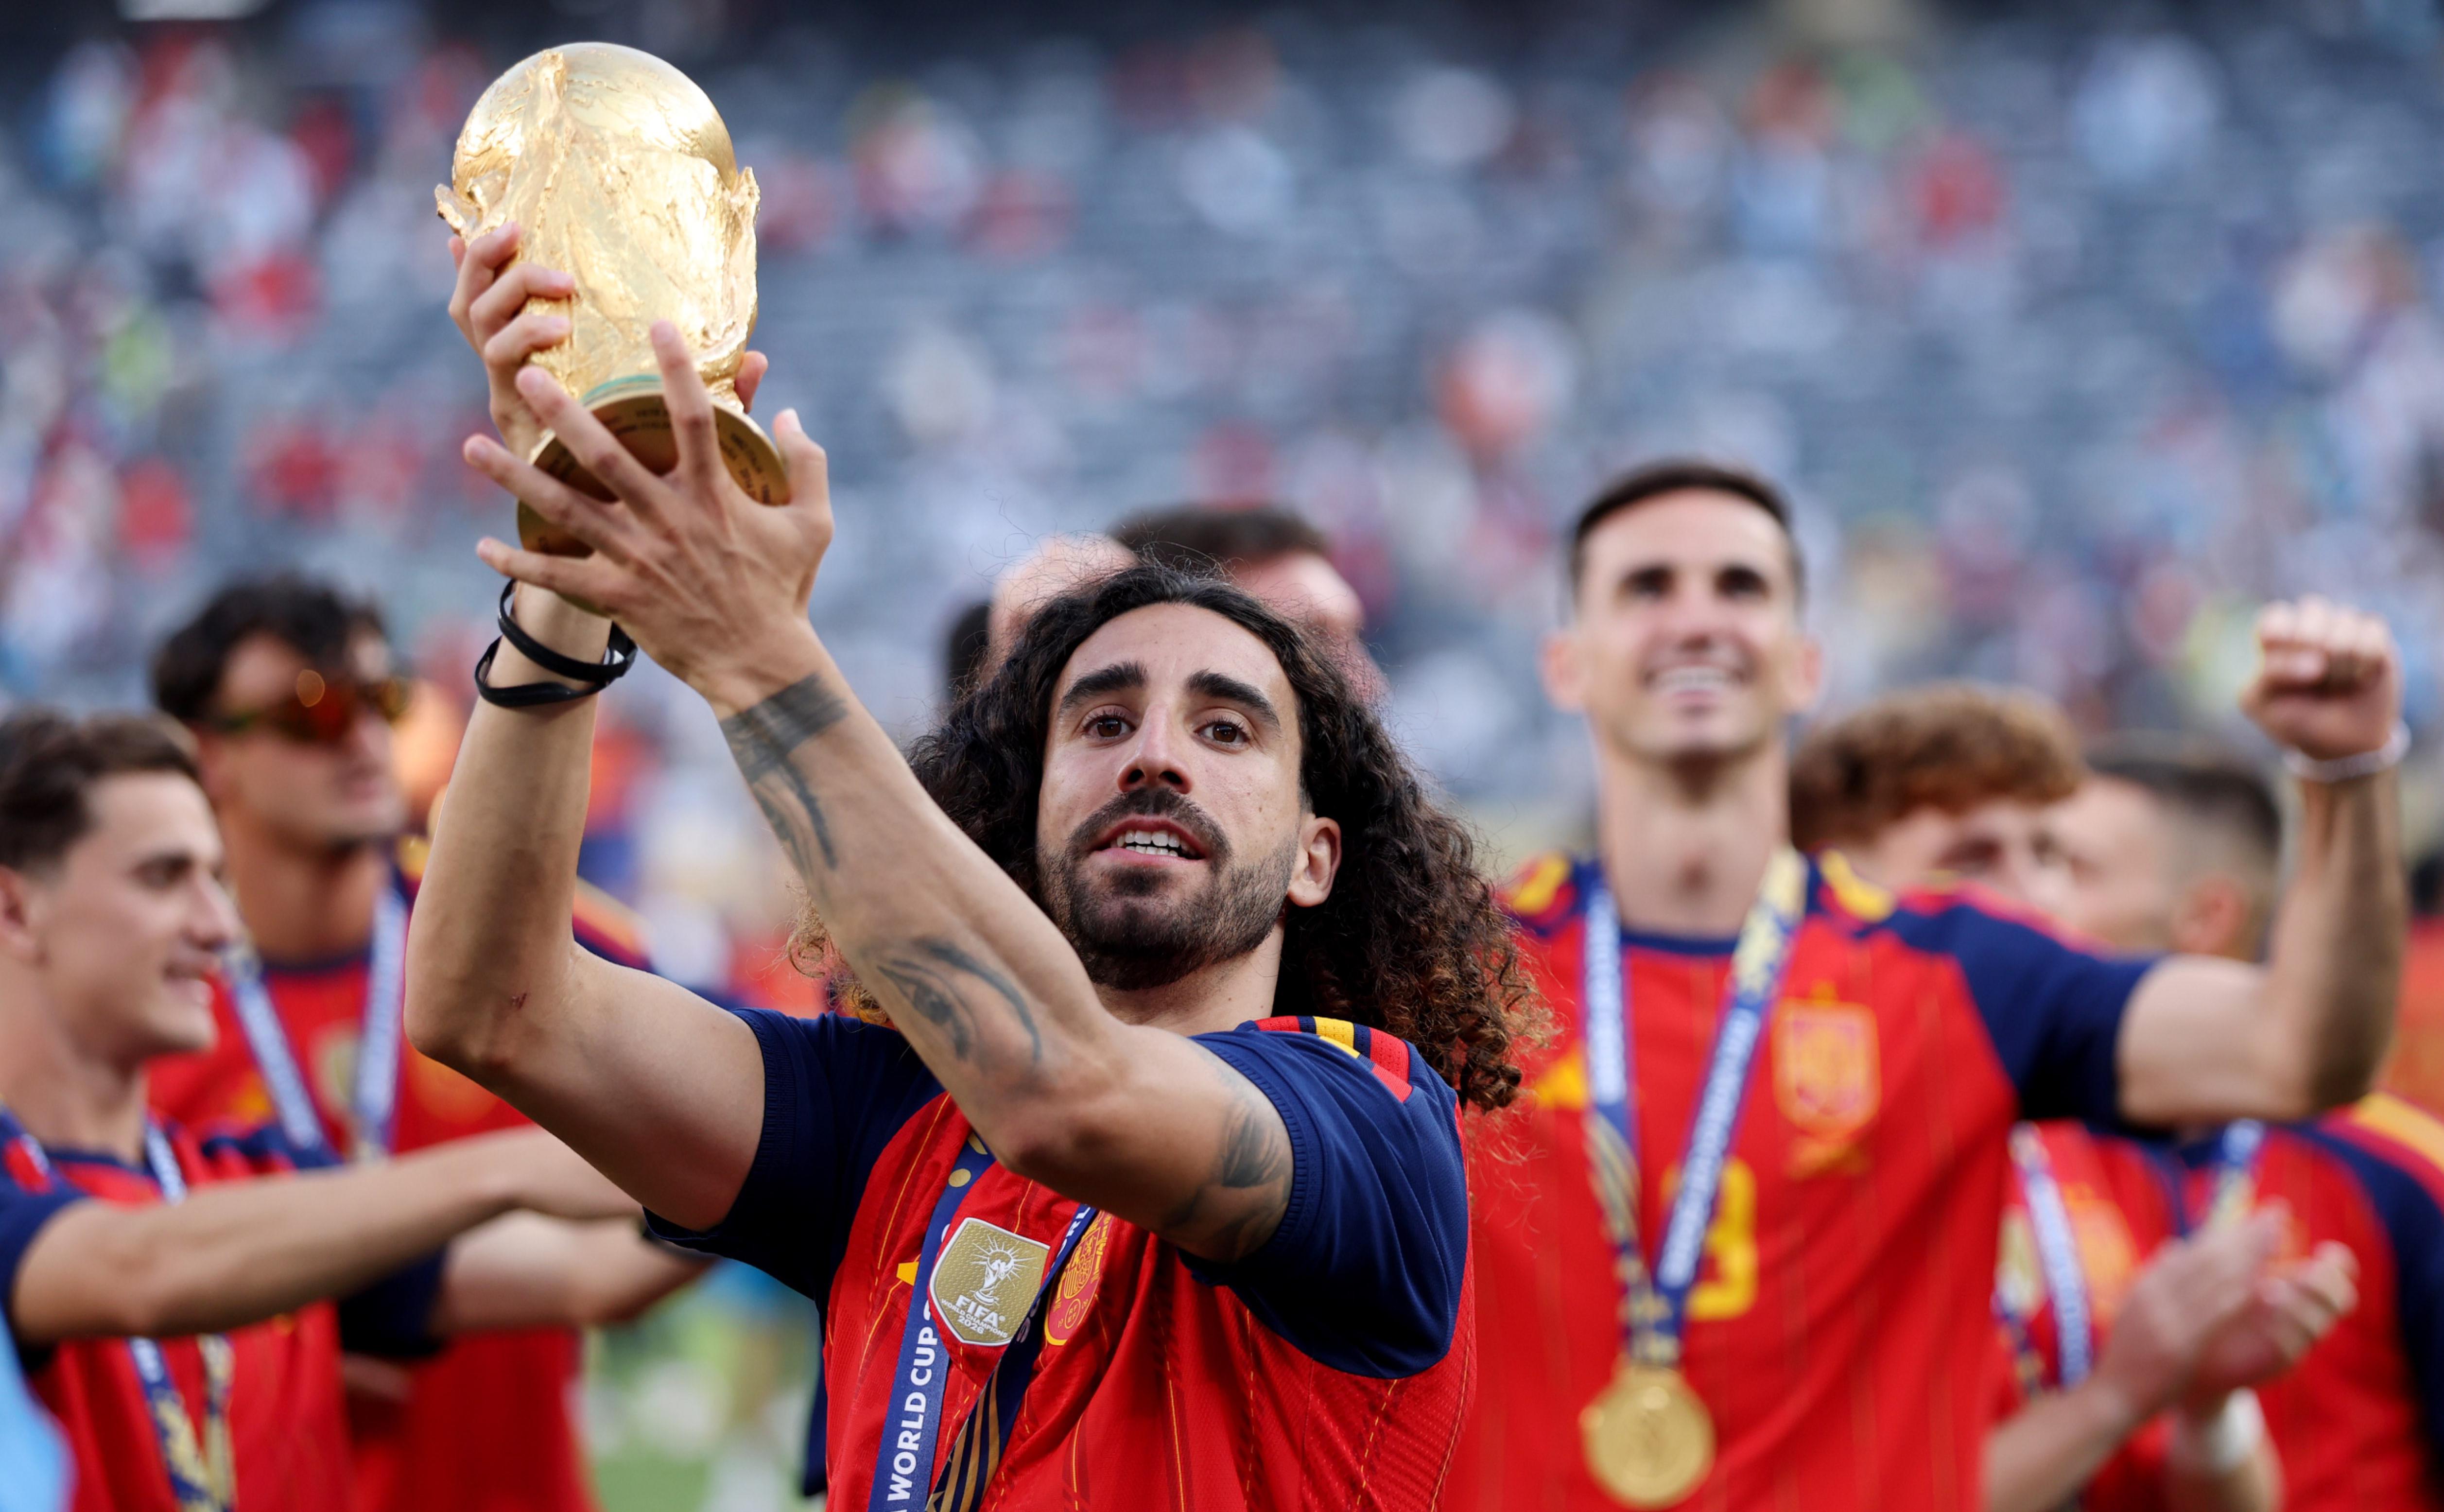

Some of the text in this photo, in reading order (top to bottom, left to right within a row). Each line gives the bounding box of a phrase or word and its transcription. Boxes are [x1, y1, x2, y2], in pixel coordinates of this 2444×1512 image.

[941, 1298, 966, 1316] WORLD
[966, 1313, 1008, 1338] CHAMPIONS
[957, 1315, 985, 1335] 2026
[887, 1391, 926, 1501] WORLD
[910, 1326, 938, 1386] CUP
